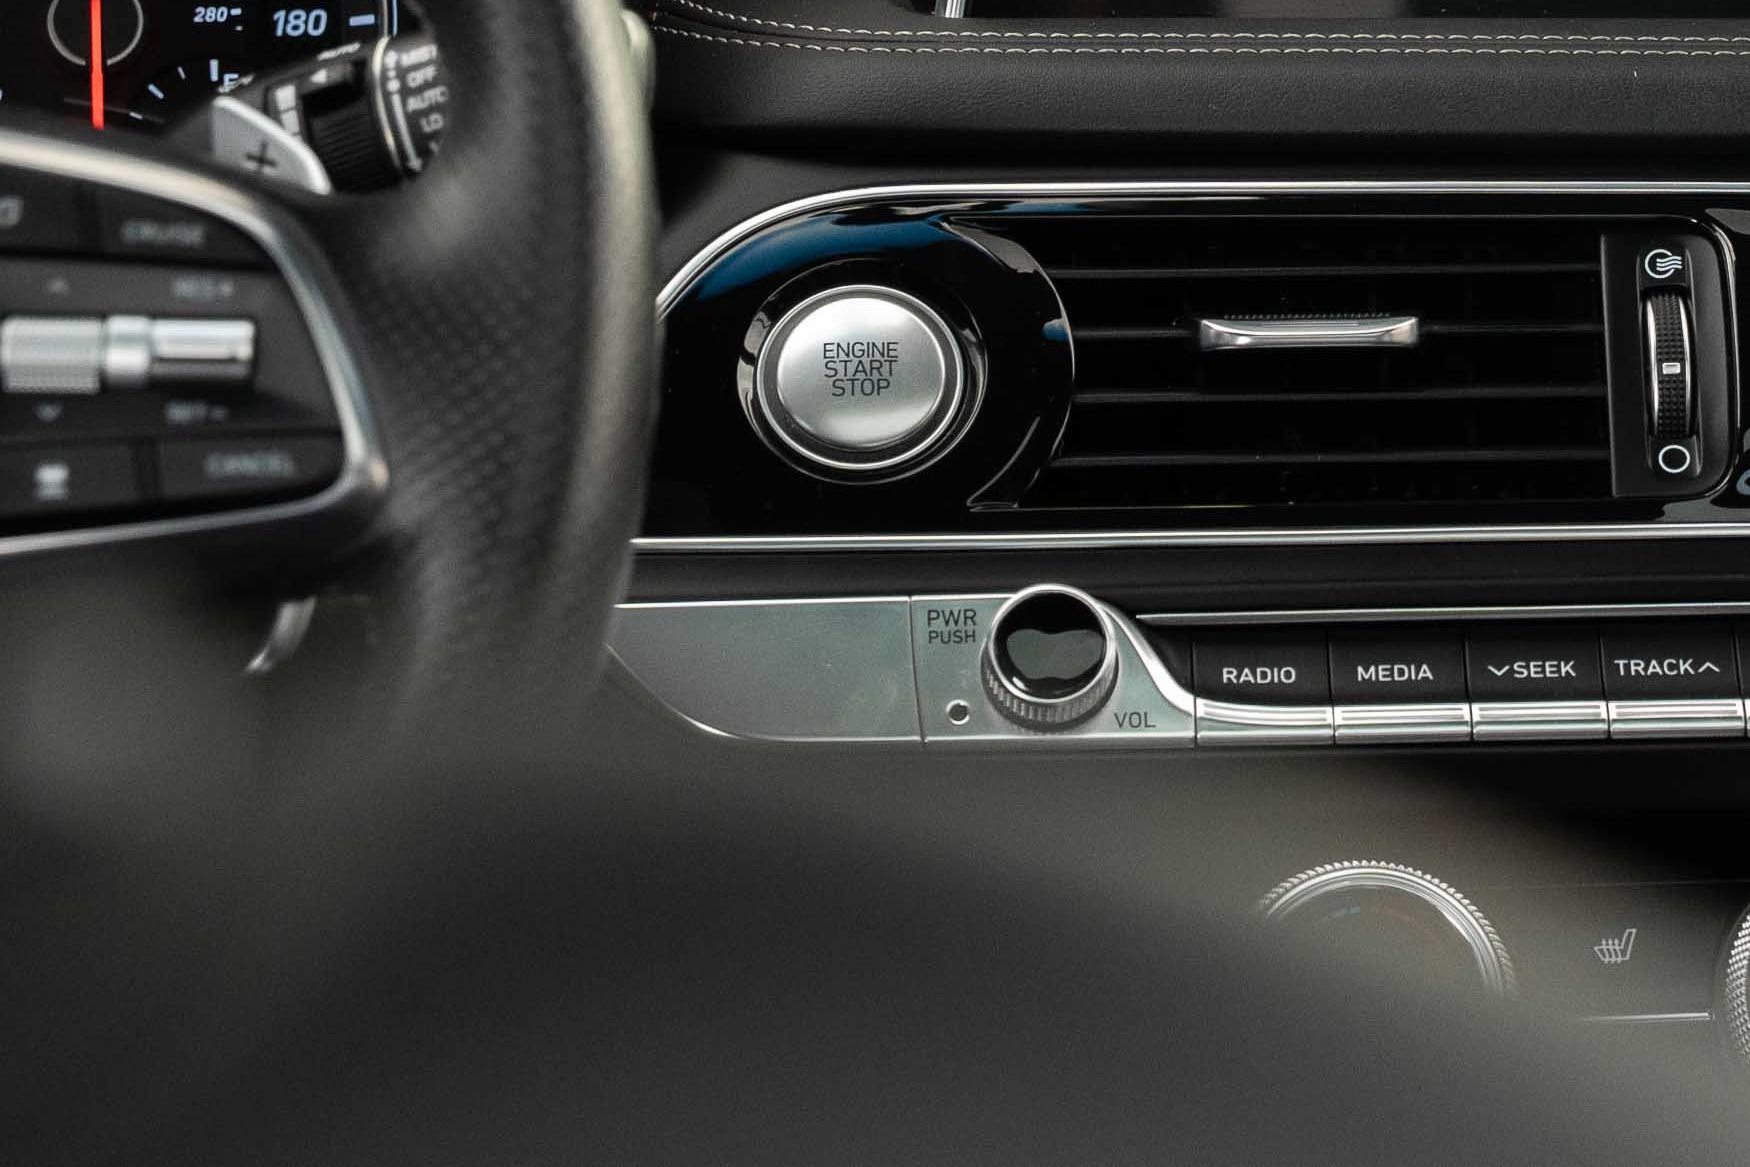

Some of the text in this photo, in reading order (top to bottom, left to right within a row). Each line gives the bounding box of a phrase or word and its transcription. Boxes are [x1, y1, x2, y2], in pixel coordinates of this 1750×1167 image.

[193, 6, 228, 23] 280
[272, 9, 328, 37] 180
[823, 341, 899, 359] ENGINE
[824, 359, 899, 378] START
[831, 378, 891, 396] STOP
[927, 609, 977, 627] PWR
[928, 630, 977, 645] PUSH
[1222, 666, 1297, 684] RADIO
[1357, 663, 1433, 682] MEDIA
[1513, 659, 1577, 679] SEEK
[1614, 658, 1696, 677] TRACK
[1114, 711, 1156, 730] VOL
